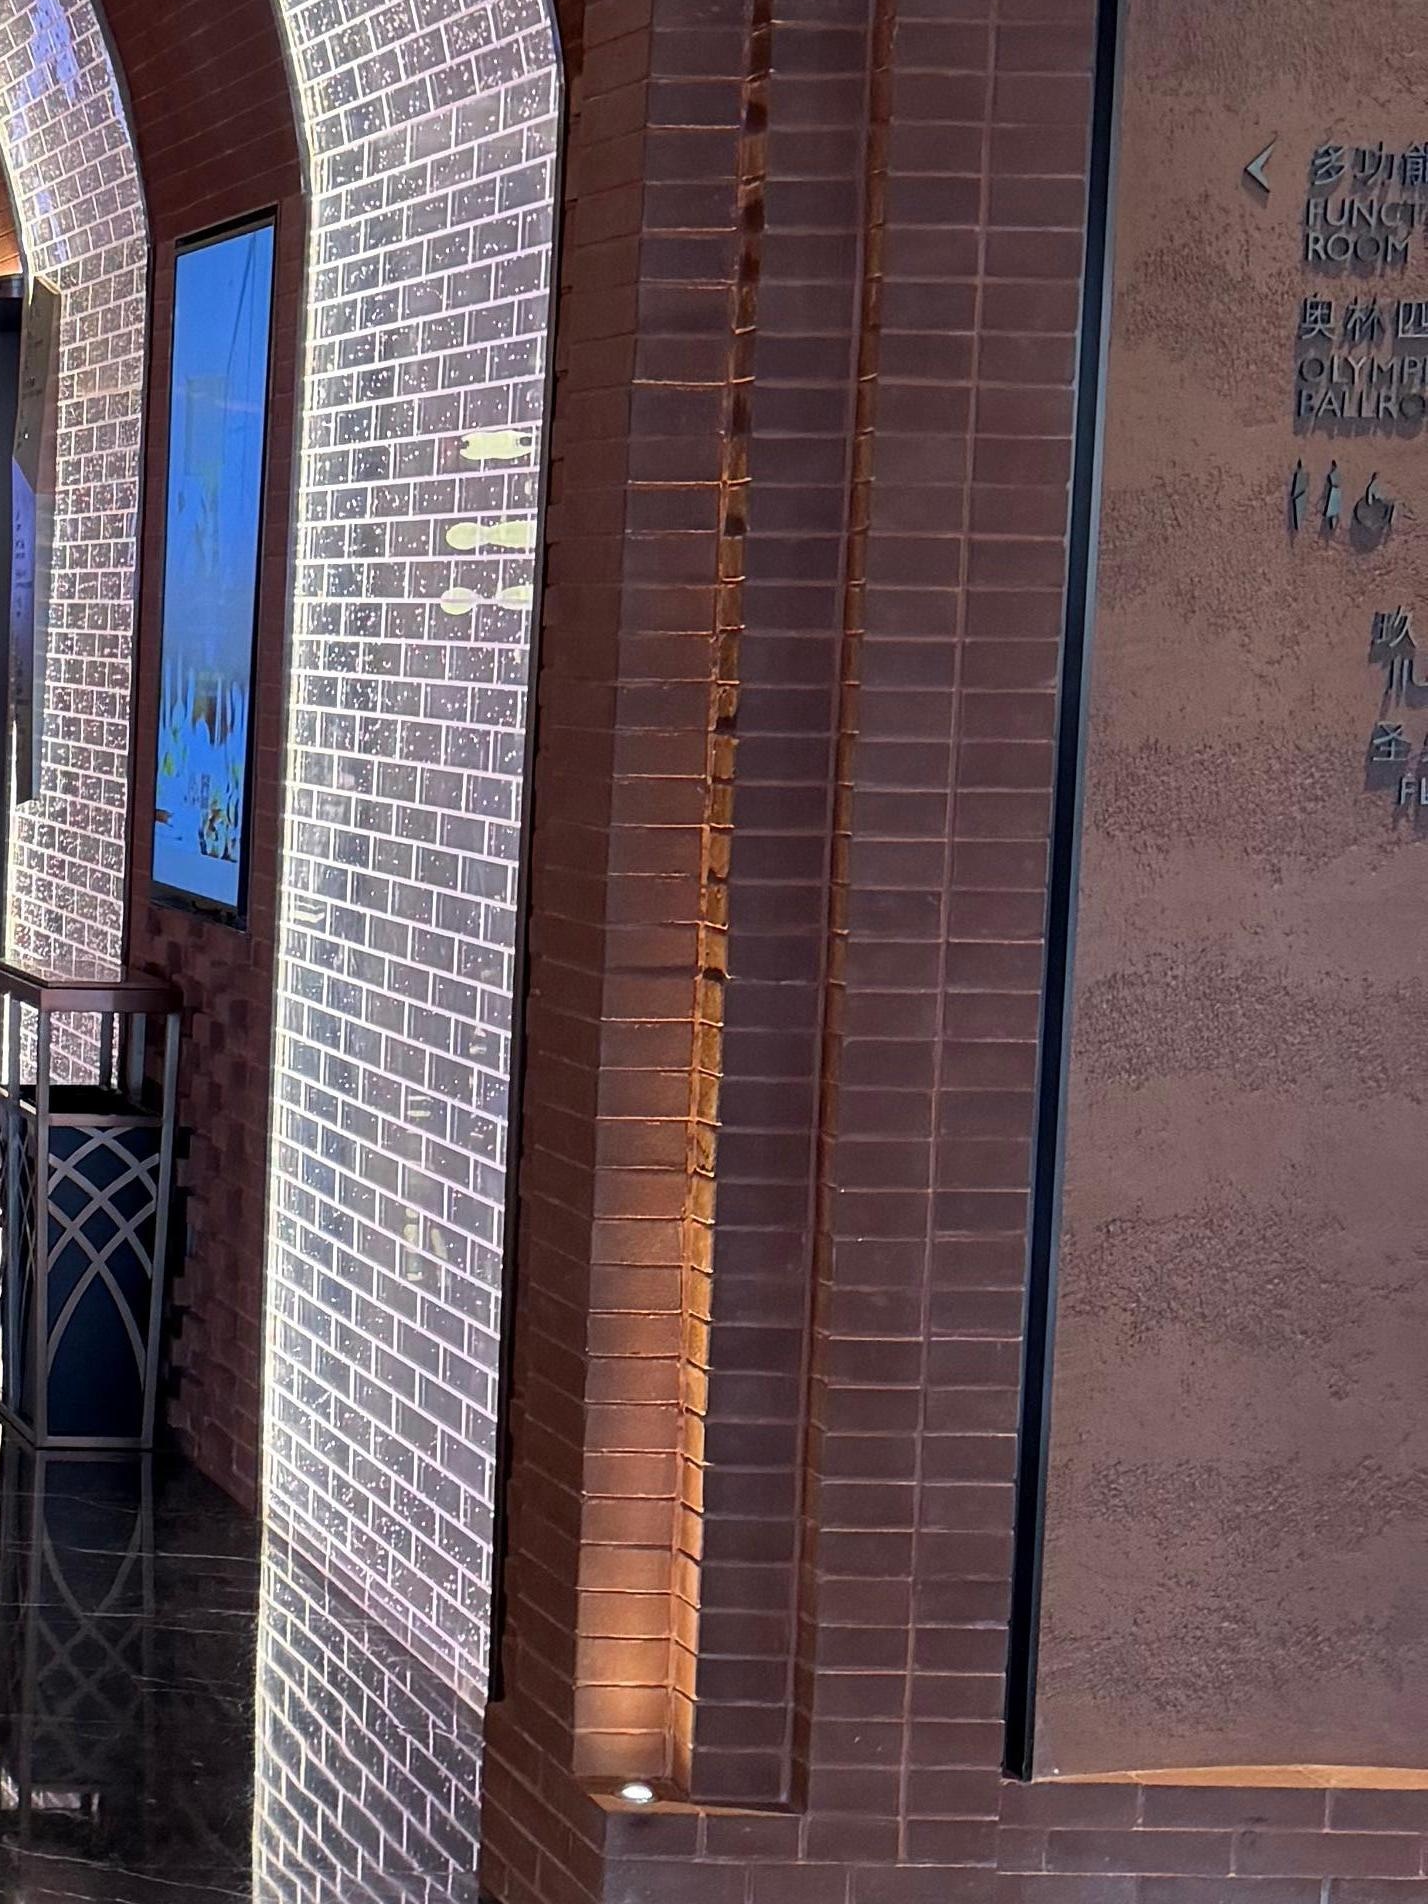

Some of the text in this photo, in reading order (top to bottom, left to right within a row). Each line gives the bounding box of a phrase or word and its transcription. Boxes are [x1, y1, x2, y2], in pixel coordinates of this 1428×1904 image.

[1304, 232, 1411, 263] ROOM
[1300, 293, 1428, 341] 奥林匹
